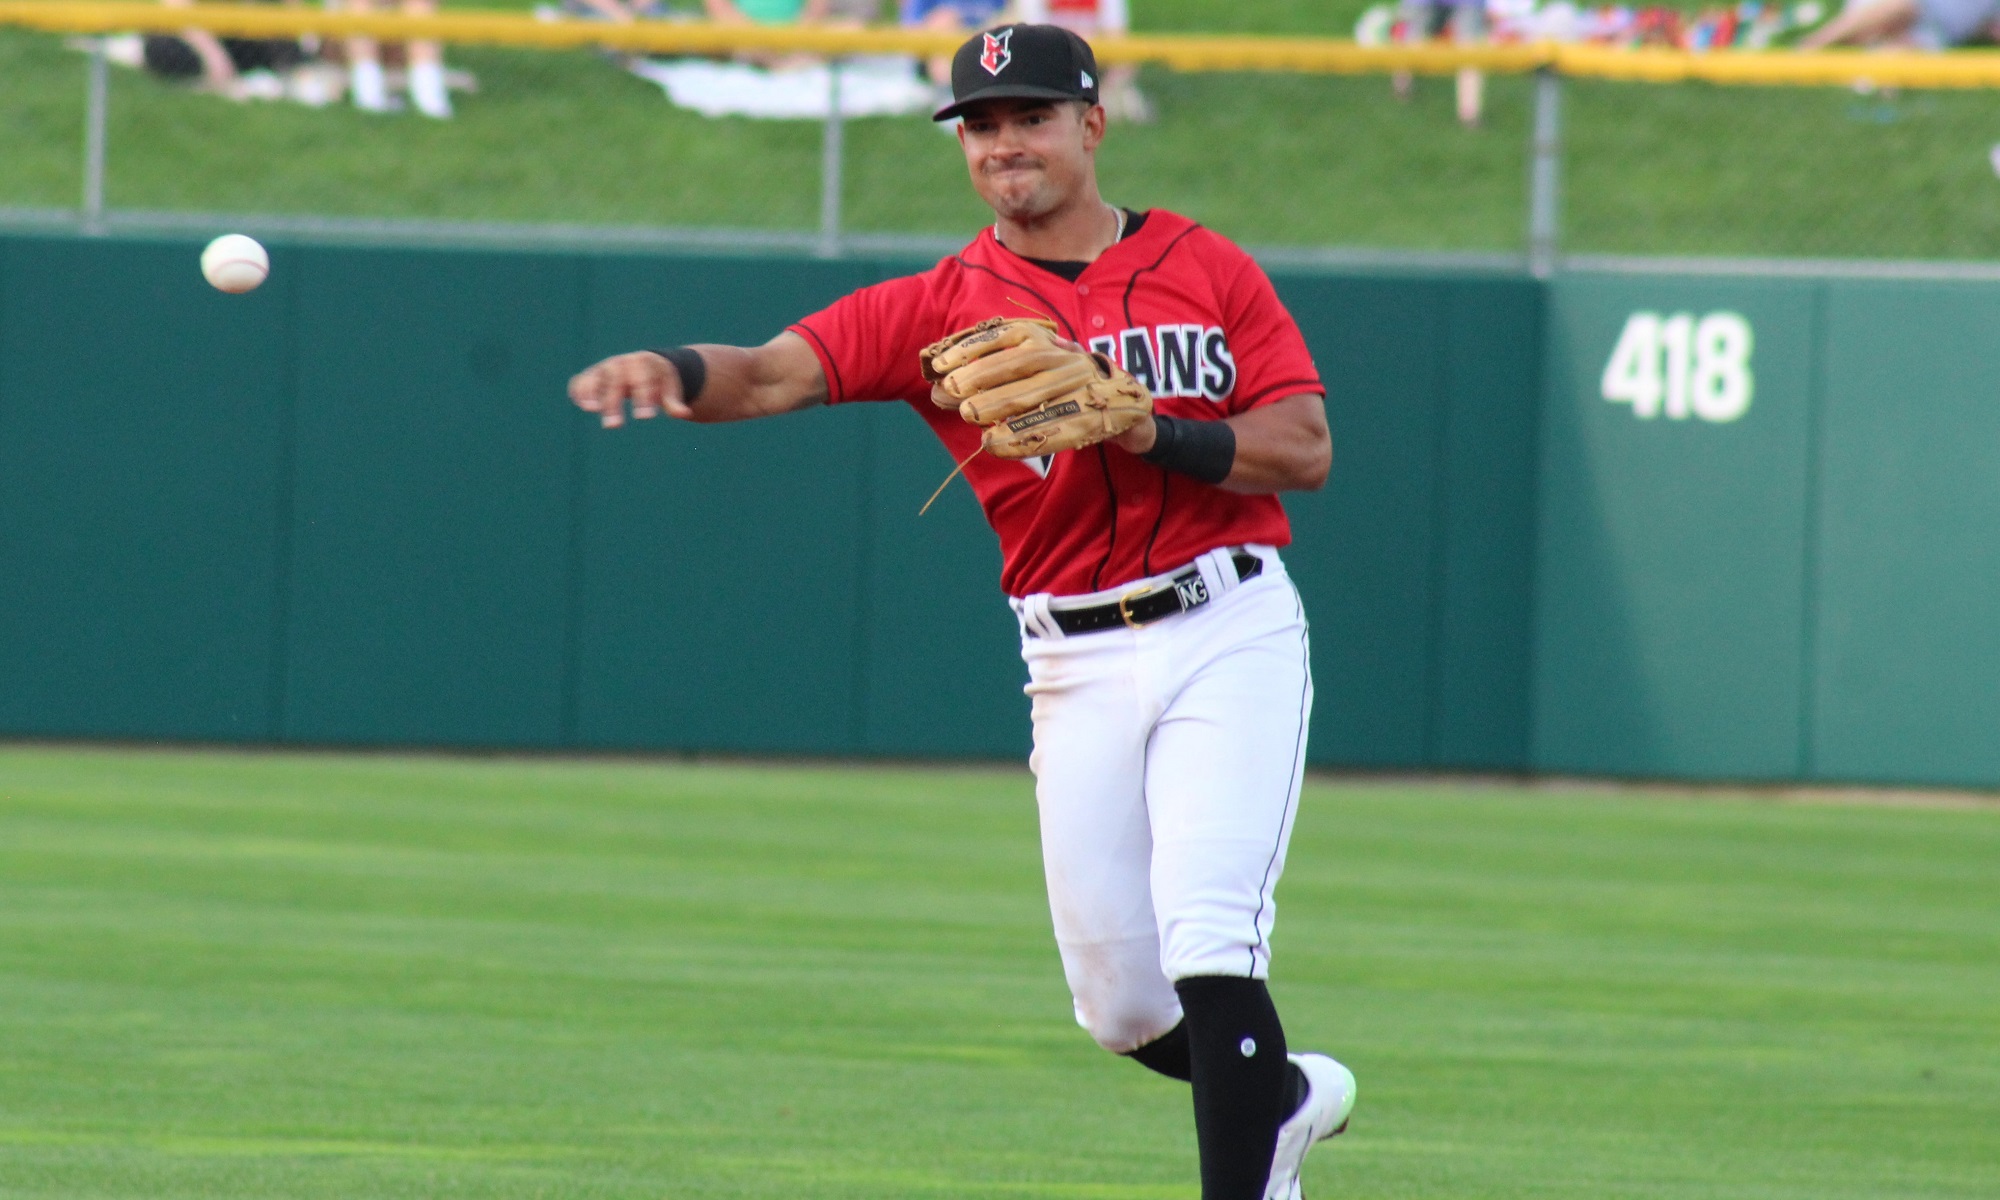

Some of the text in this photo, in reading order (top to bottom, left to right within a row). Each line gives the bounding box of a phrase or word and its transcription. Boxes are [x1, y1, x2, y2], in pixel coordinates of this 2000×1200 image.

[1602, 313, 1754, 422] 418
[1011, 421, 1025, 431] THE
[1026, 414, 1045, 424] GOLD
